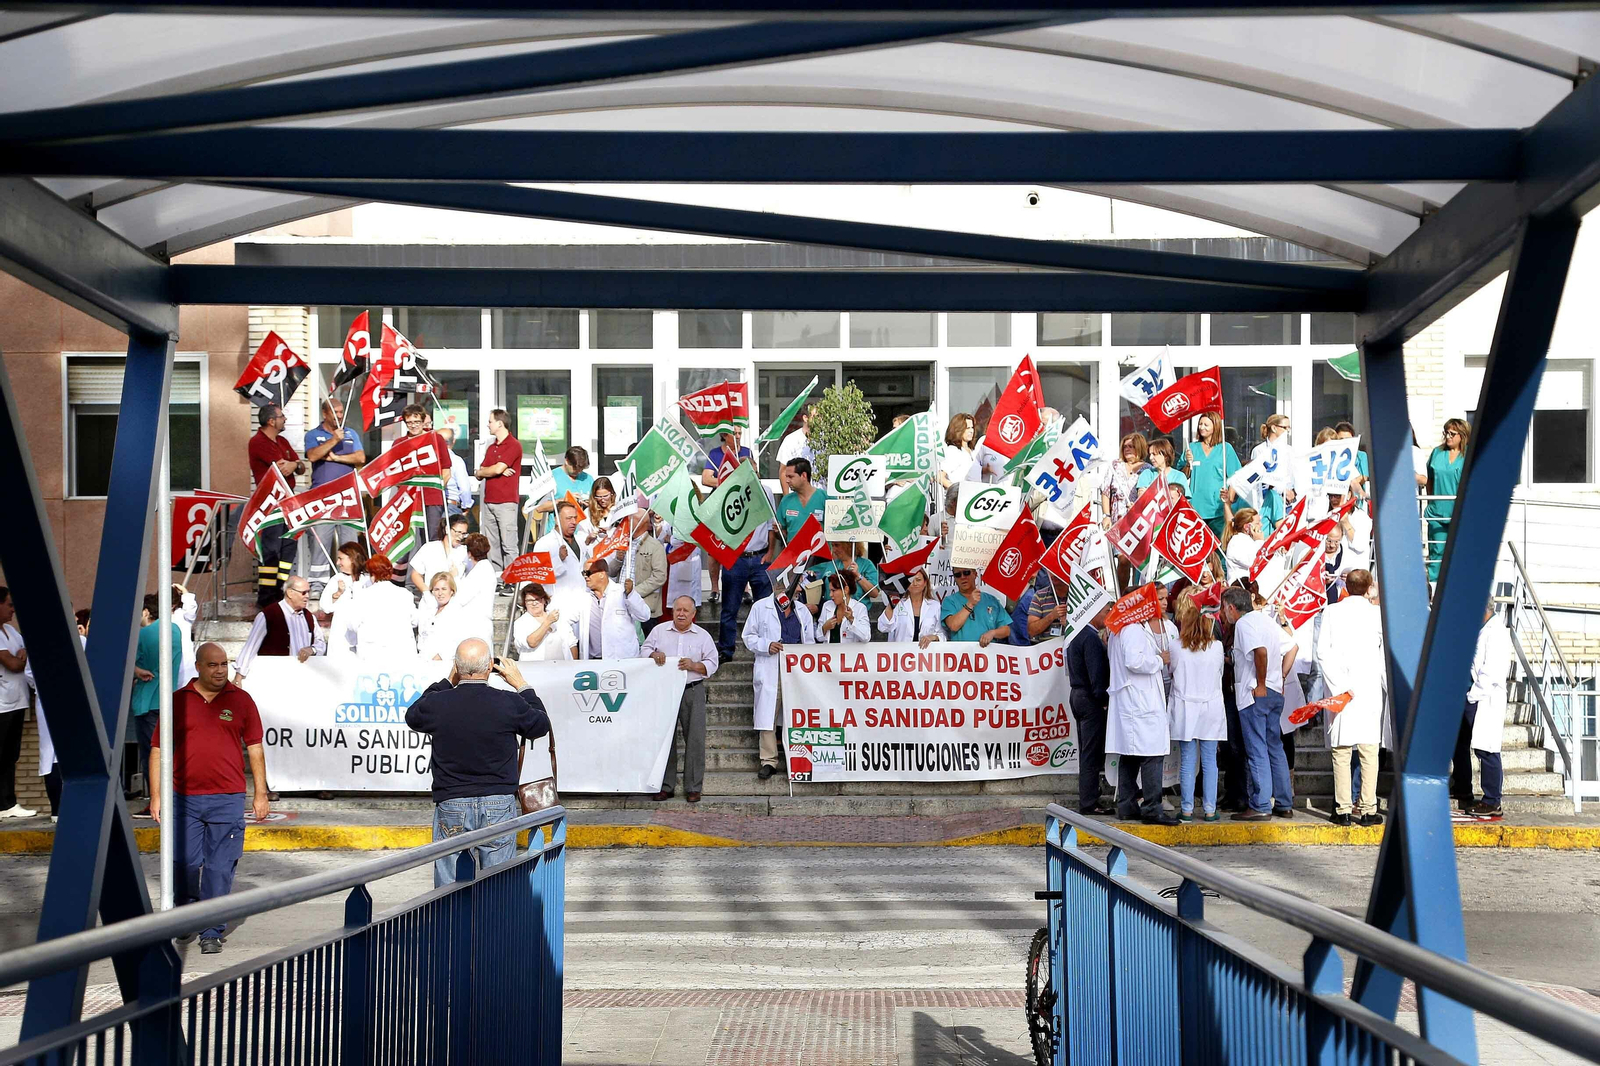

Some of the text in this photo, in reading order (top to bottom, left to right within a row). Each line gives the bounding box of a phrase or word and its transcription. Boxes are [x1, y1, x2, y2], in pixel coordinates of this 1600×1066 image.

[1170, 513, 1196, 551] UGT
[513, 556, 541, 567] SMA
[1116, 593, 1146, 613] SMA
[786, 647, 1065, 676] POR LA DIGNIDAD DE LOS
[839, 680, 1022, 702] TRABAJADORES
[792, 703, 1068, 729] DE LA SANIDAD PÚBLICA
[306, 728, 347, 748] UNA
[790, 730, 842, 744] SATSE
[861, 742, 979, 772] SUSTITUCIONES
[984, 743, 1005, 770] YA
[789, 772, 810, 780] CGT
